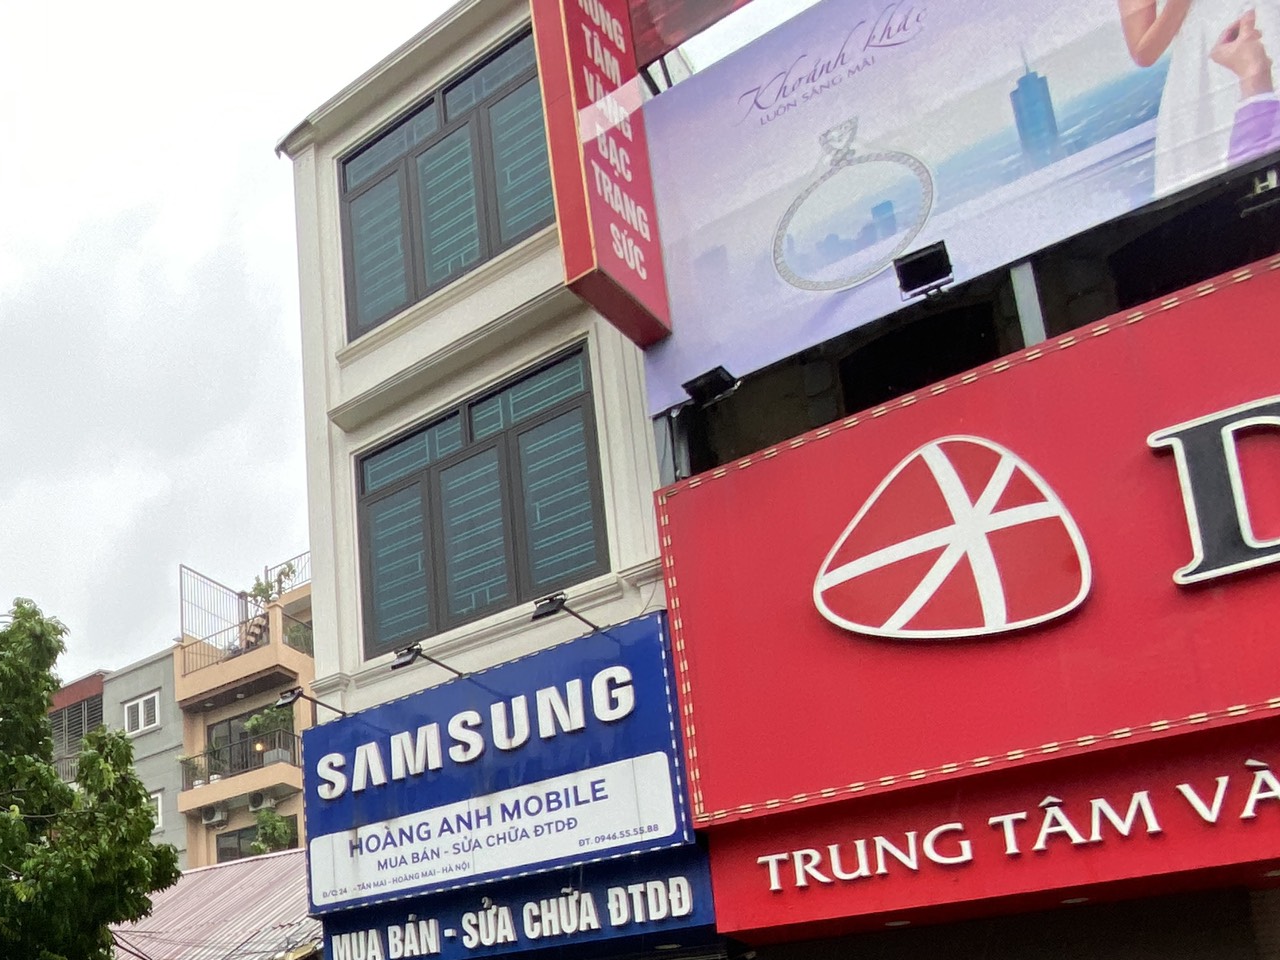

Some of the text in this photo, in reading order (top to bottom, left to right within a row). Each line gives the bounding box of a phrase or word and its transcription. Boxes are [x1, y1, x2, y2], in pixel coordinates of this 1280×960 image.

[581, 23, 622, 87] TÂM
[595, 121, 633, 182] BẠC
[591, 159, 651, 242] TRANG
[317, 665, 635, 800] SAMSUNG
[348, 779, 609, 858] HOÀNG ANH MOBILE
[377, 855, 408, 871] MUA
[411, 847, 440, 864] BÁN
[452, 835, 483, 855] SỬA
[486, 826, 531, 848] CHỮA
[533, 817, 578, 838] ĐTDĐ
[595, 823, 659, 844] 0946.55.55.88
[757, 822, 974, 891] TRUNG
[988, 791, 1163, 856] TÂM
[373, 879, 387, 888] MAI
[421, 869, 436, 879] MAI
[387, 912, 441, 959] BÁN
[443, 928, 457, 939] -
[461, 896, 518, 950] SỬA
[522, 886, 602, 940] CHỮA
[607, 876, 694, 927] ĐTDĐ
